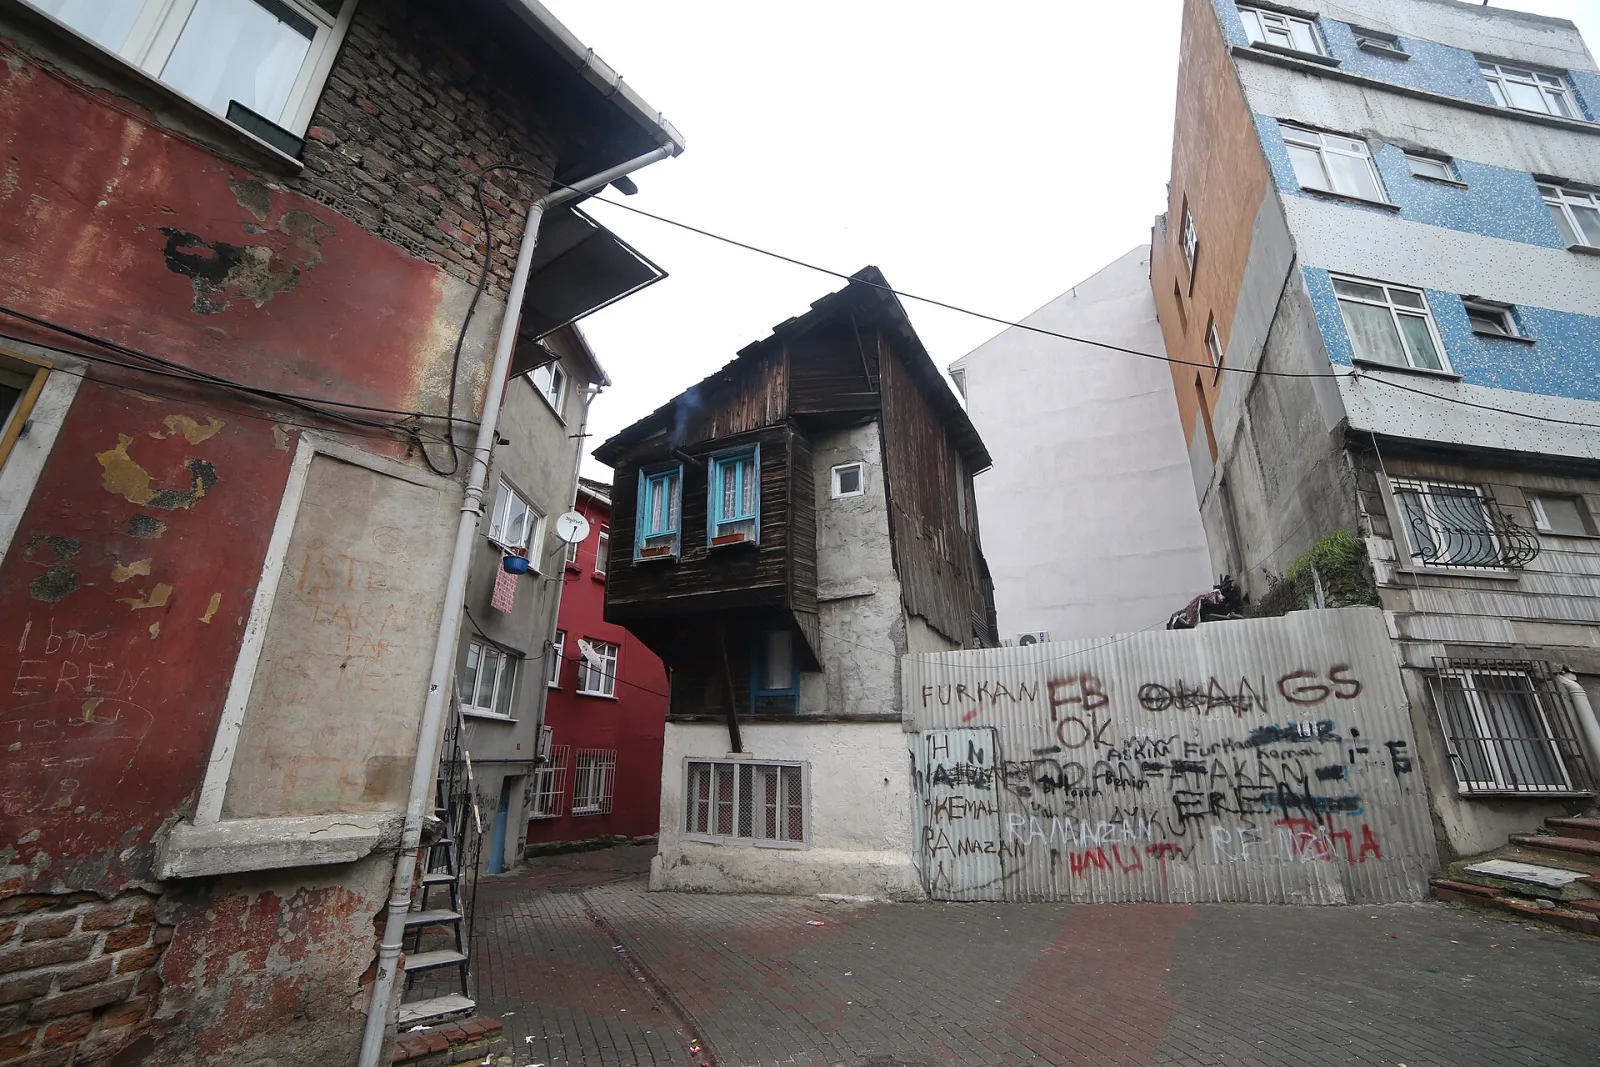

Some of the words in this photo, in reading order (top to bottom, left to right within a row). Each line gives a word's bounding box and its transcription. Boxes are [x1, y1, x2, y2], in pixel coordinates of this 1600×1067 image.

[12, 659, 149, 697] EREN
[922, 680, 1039, 708] FURKAN
[1046, 672, 1110, 721] FB
[1277, 664, 1364, 707] GS
[935, 795, 999, 826] KEMAL
[921, 825, 1026, 860] RAMAZAN
[1006, 811, 1152, 849] RAMAZAN
